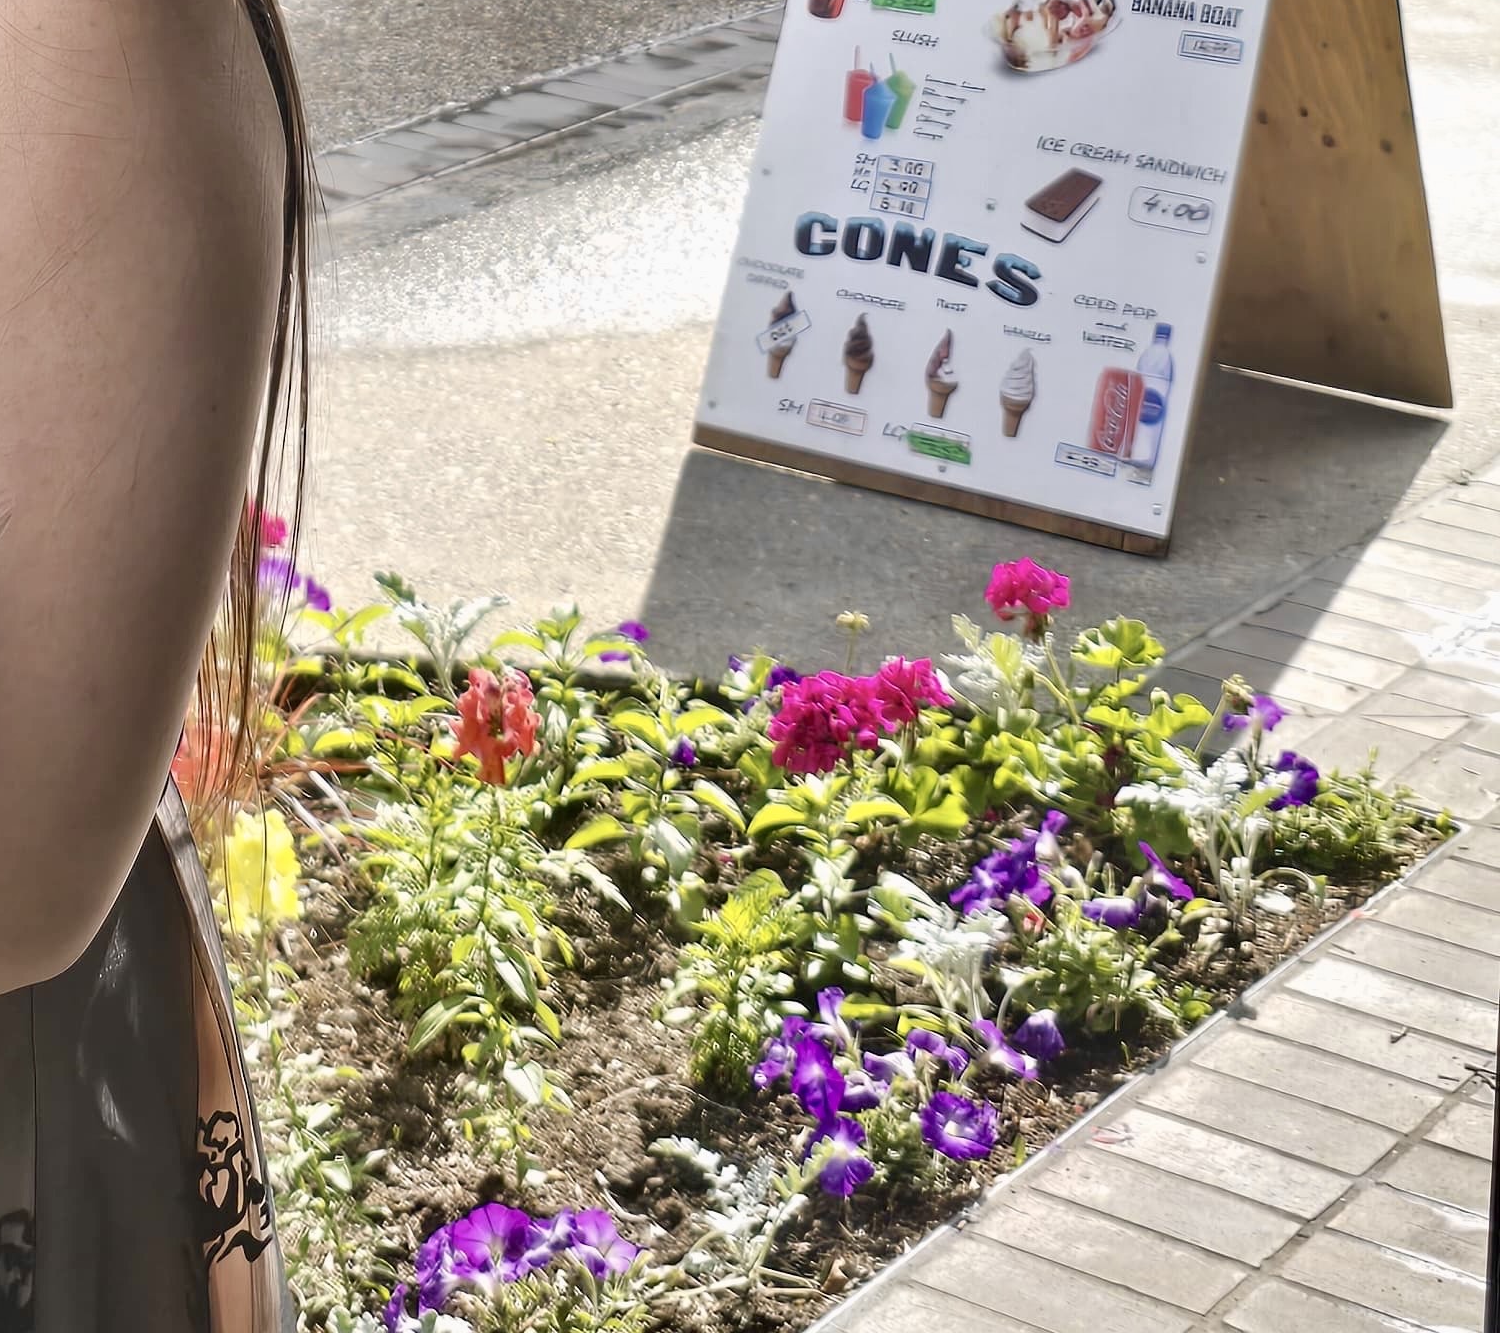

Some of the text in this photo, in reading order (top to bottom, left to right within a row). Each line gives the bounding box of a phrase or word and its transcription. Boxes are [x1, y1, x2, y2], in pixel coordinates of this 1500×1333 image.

[1200, 4, 1244, 27] BOAT
[1037, 135, 1228, 184] ICE CREAM SANDWICH
[793, 211, 1043, 307] CONES
